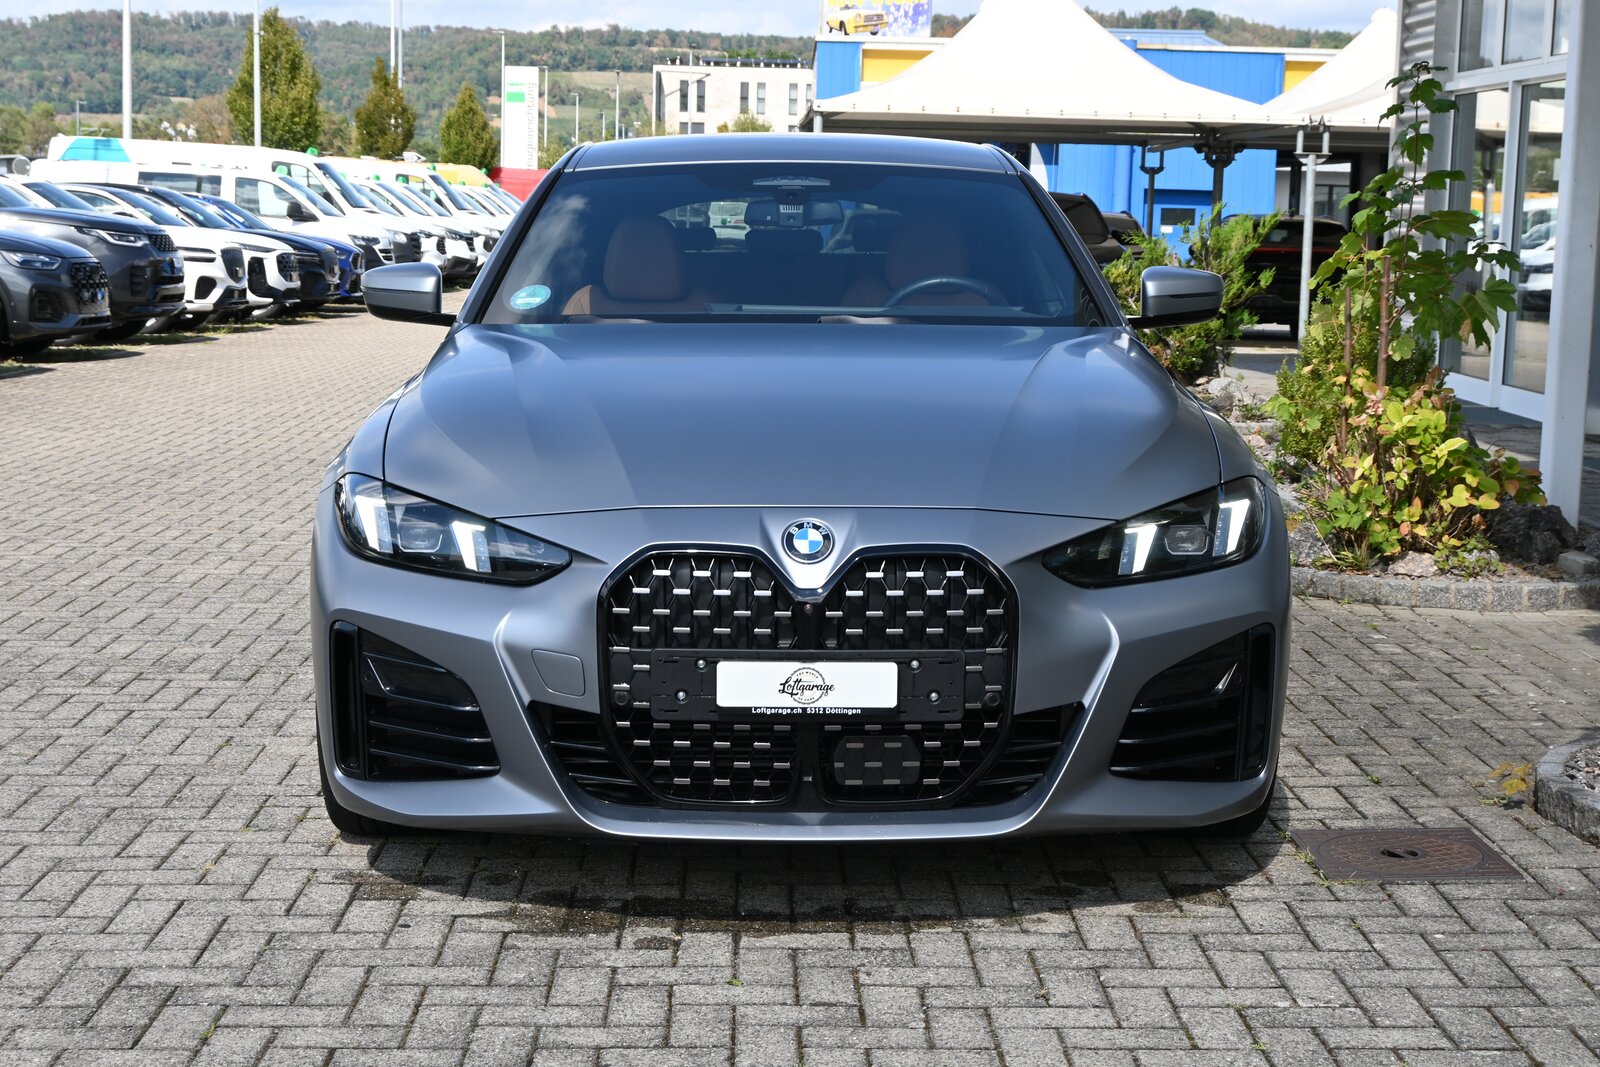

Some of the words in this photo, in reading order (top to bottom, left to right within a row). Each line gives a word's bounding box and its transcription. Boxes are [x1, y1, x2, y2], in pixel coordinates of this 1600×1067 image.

[790, 522, 829, 535] BMW
[778, 676, 835, 698] Loftgarage
[825, 707, 861, 715] Döttingen
